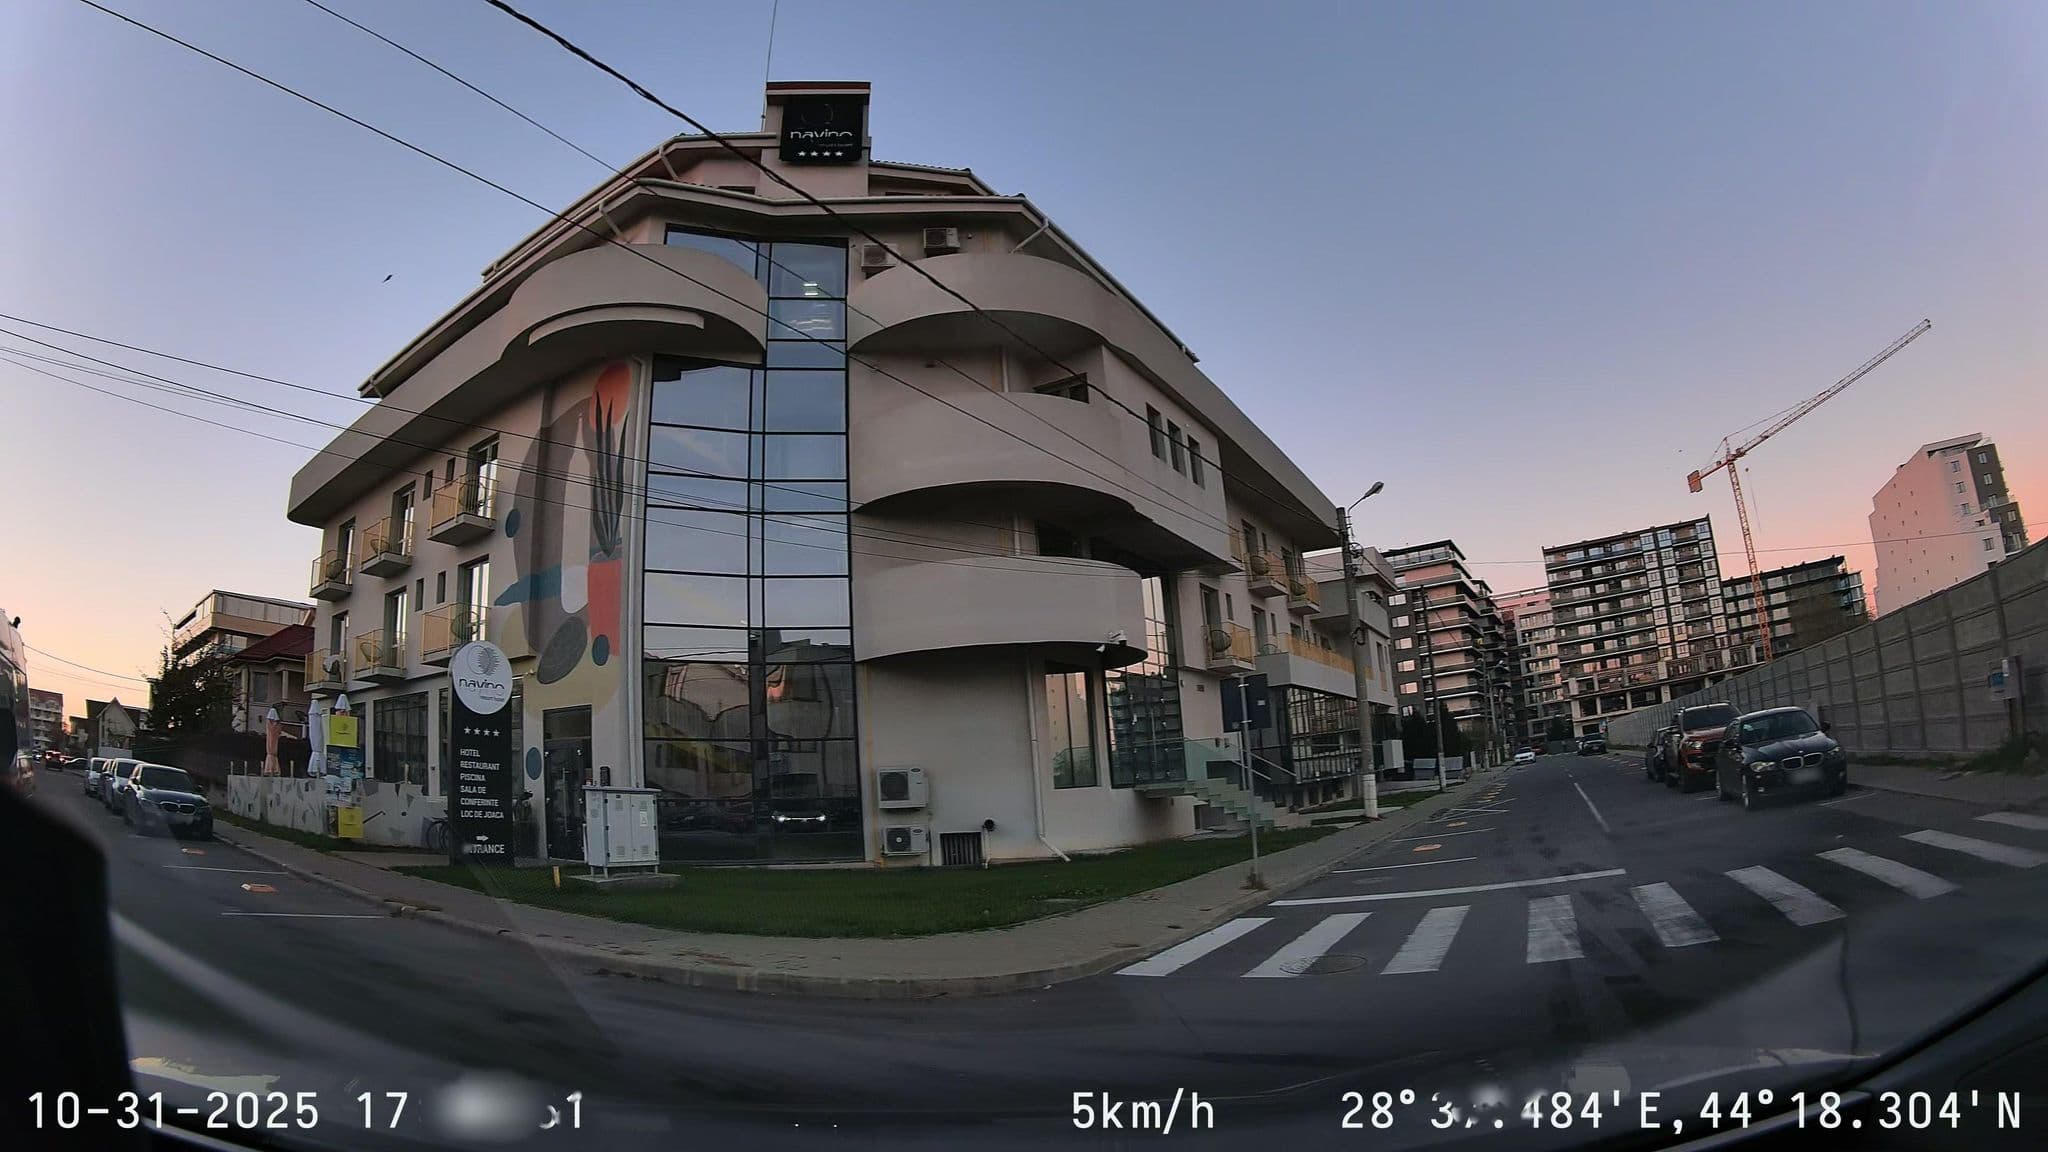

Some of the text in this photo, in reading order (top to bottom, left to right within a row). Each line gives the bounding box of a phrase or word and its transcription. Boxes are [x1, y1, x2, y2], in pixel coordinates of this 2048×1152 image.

[460, 748, 480, 757] HOTEL
[460, 761, 500, 771] RESTAURANT
[460, 773, 486, 781] PISCINA
[460, 785, 487, 794] SALA DE
[461, 810, 505, 819] LOC DE JOACA
[463, 844, 505, 854] TRANCE
